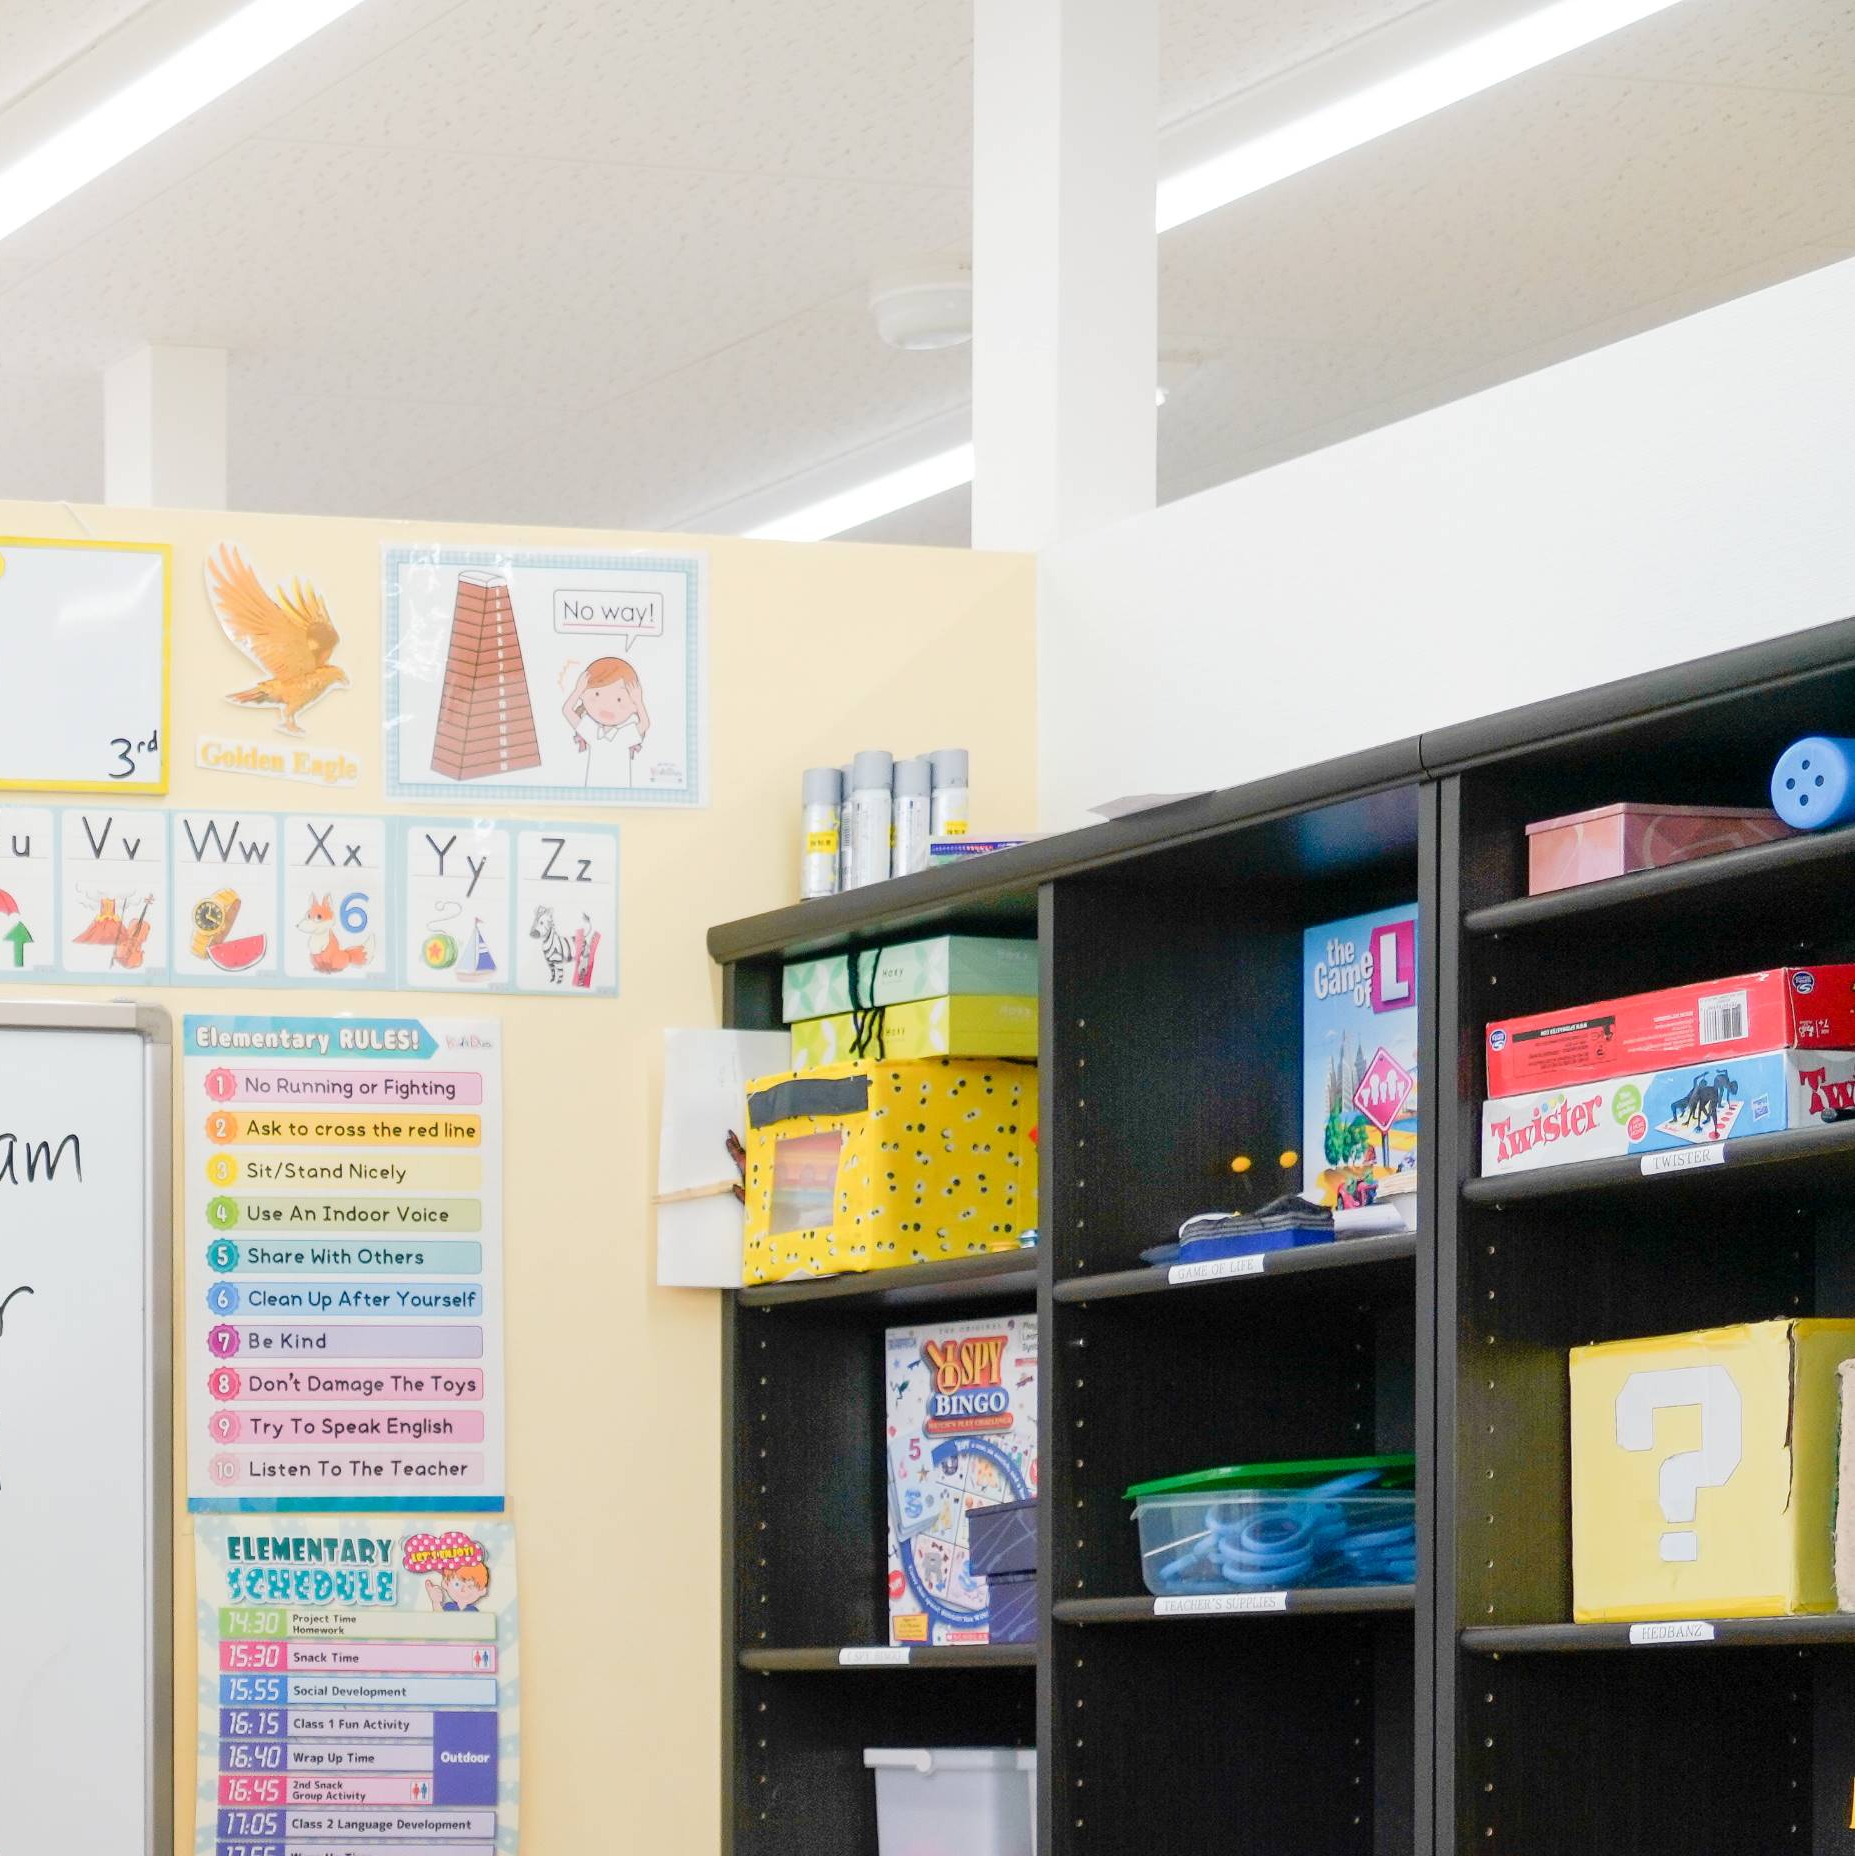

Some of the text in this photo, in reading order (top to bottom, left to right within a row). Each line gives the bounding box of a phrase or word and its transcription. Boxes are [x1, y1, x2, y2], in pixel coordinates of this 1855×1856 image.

[563, 600, 655, 627] No way!
[200, 741, 358, 781] Golden Eagle
[1326, 938, 1356, 964] the
[1314, 946, 1374, 1001] Game
[1353, 978, 1372, 1009] of
[196, 1026, 330, 1055] Elementary
[339, 1026, 420, 1050] RULES!
[245, 1077, 456, 1100] No Running or Fighting
[246, 1119, 476, 1139] Ask to cross the red line
[1490, 1094, 1603, 1165] Twister
[1653, 1149, 1712, 1171] TWISTER
[248, 1290, 477, 1312] Clean Up After Yourself
[249, 1373, 477, 1396] Don't Damage The Toys
[934, 1391, 1007, 1417] BINGO
[250, 1417, 454, 1439] Try To Speak English
[227, 1535, 393, 1565] ELEMENTARY
[226, 1566, 394, 1603] SCHEDULE
[1642, 1624, 1703, 1640] HEDBANZ
[228, 1644, 360, 1668] 15:30 Snack Time
[228, 1678, 408, 1702] 15:55 Social Development
[440, 1751, 491, 1765] Outdoor
